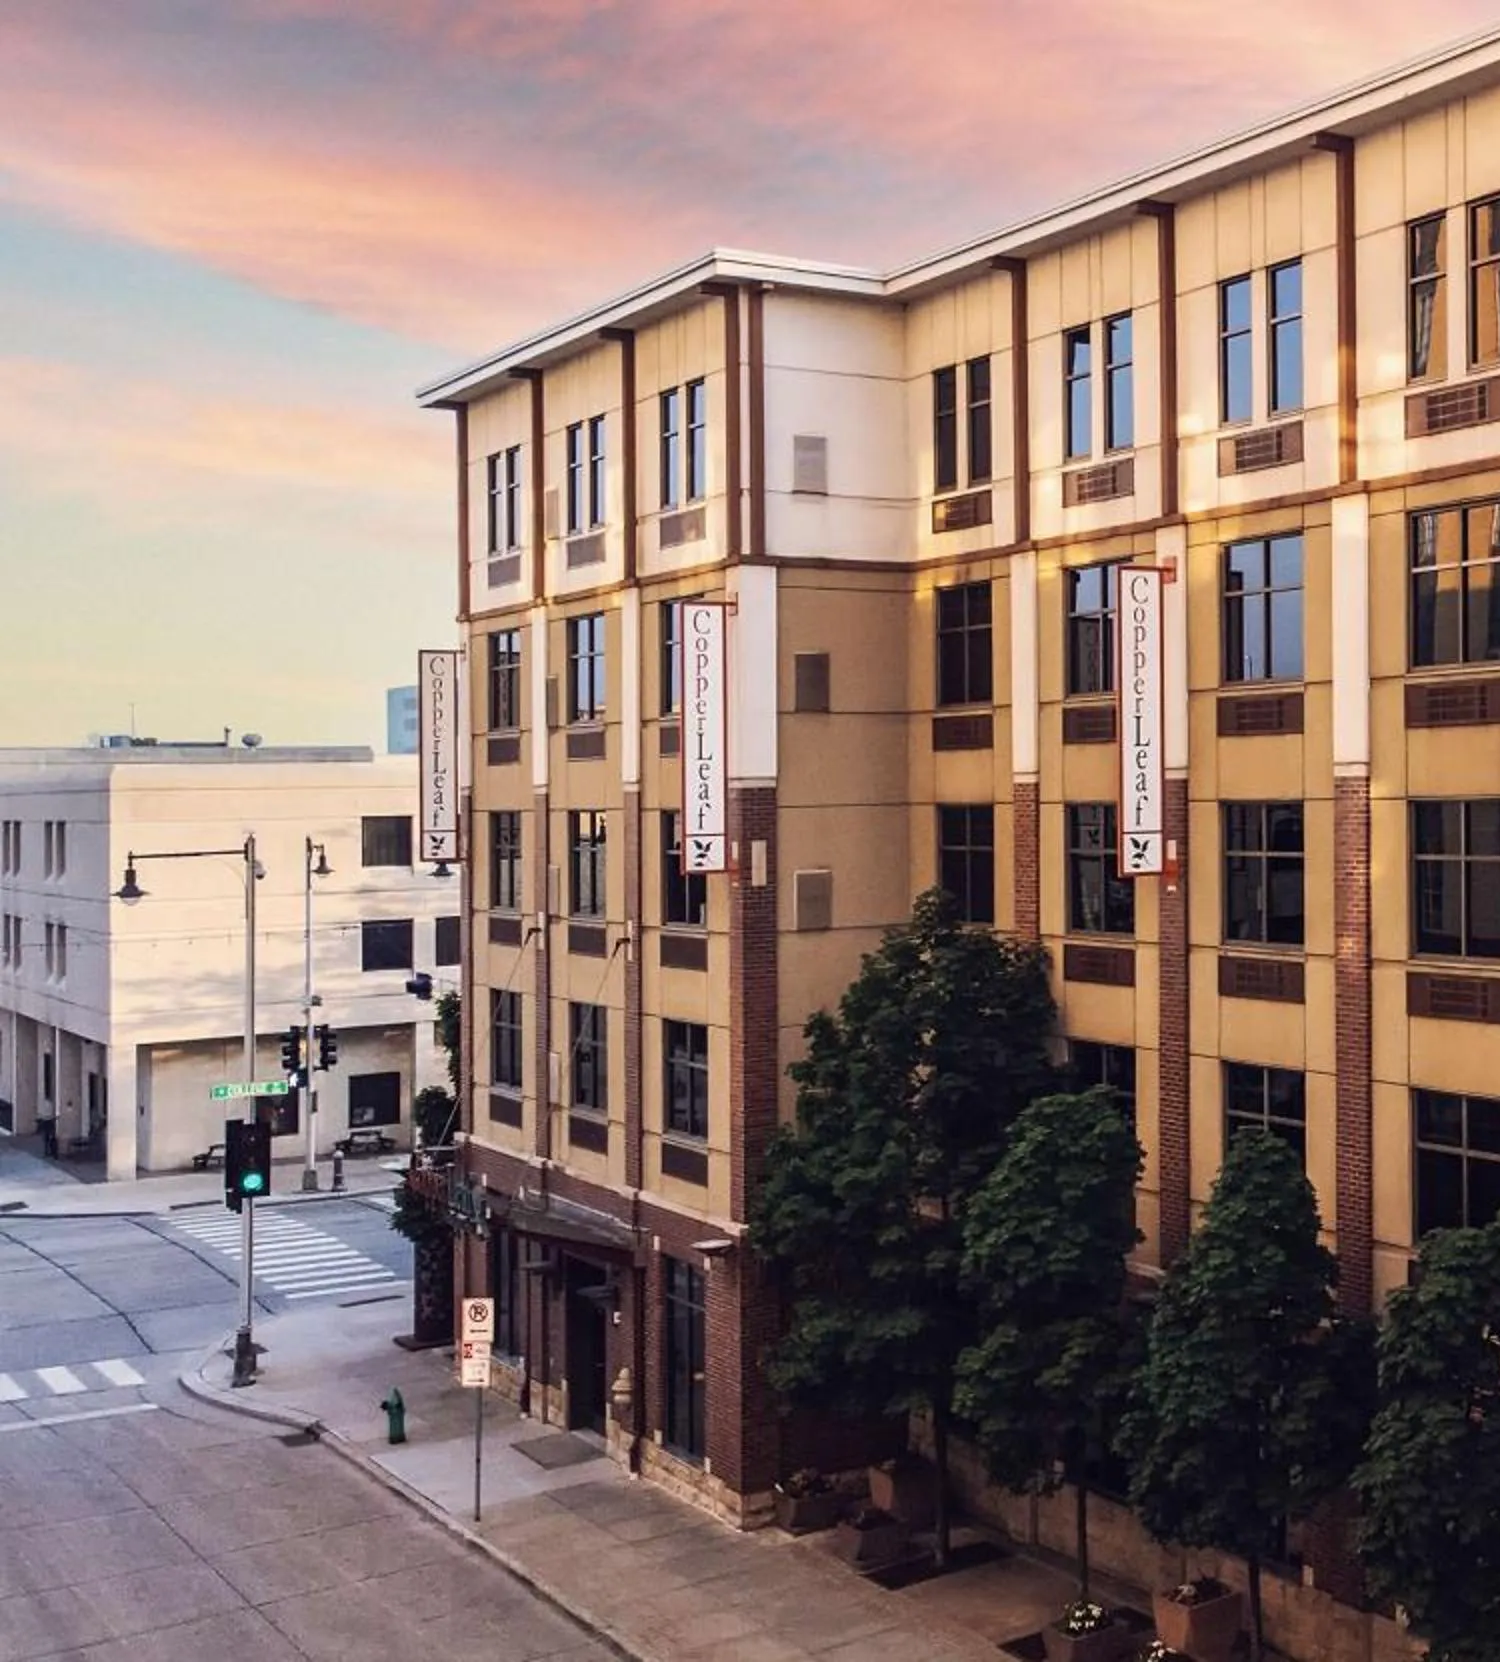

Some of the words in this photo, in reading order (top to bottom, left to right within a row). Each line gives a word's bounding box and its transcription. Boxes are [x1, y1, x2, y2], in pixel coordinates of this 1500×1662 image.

[430, 655, 446, 828] CopperLeaf
[693, 609, 713, 830] CopperLeaf
[1131, 575, 1150, 827] CopperLeaf
